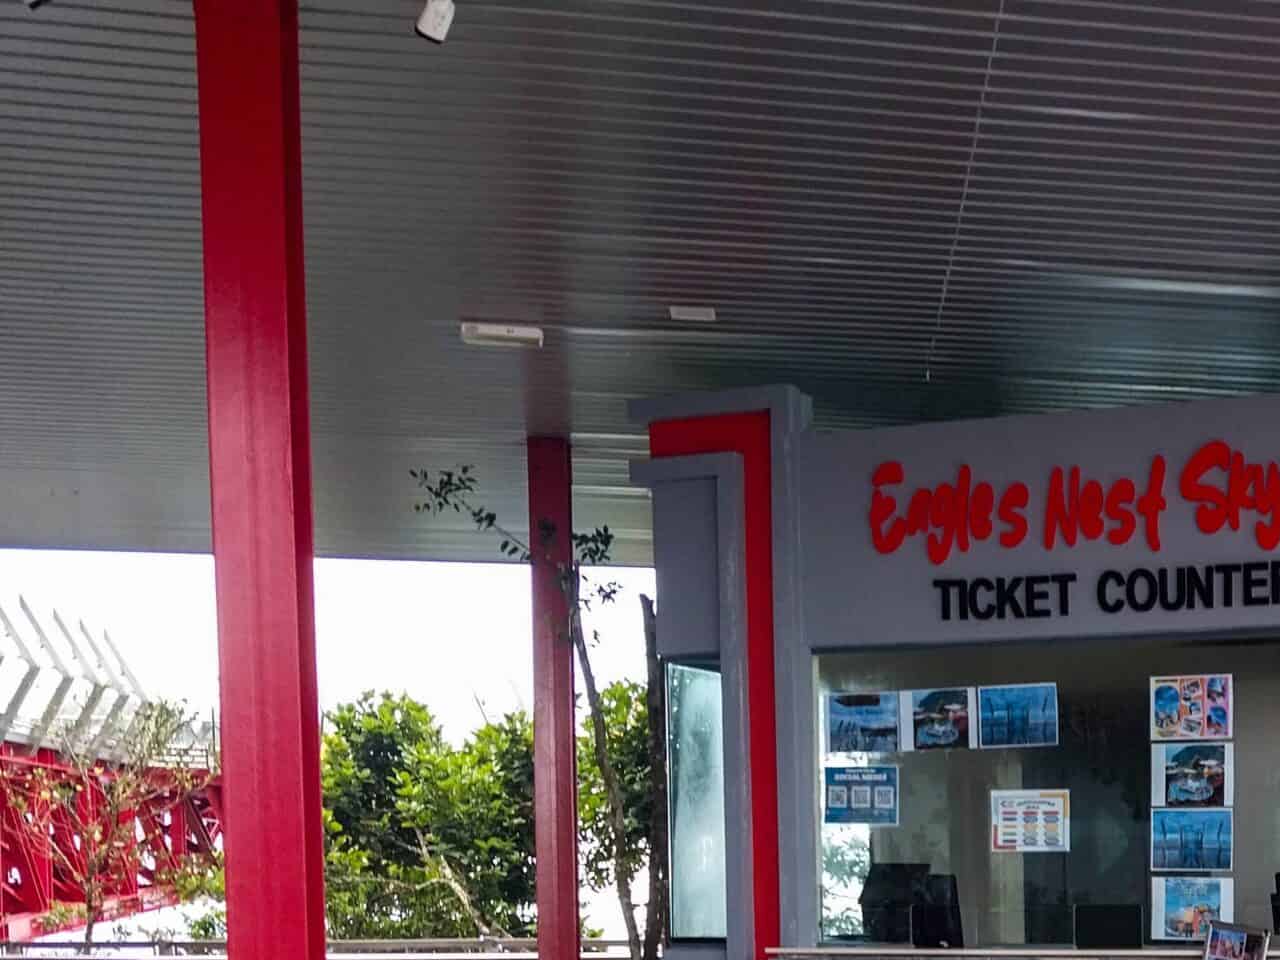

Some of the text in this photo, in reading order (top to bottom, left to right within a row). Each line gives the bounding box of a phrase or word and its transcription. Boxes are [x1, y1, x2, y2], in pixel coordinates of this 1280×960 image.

[869, 461, 1029, 565] Eagles
[1044, 454, 1166, 552] Nest
[932, 573, 1077, 622] TICKET
